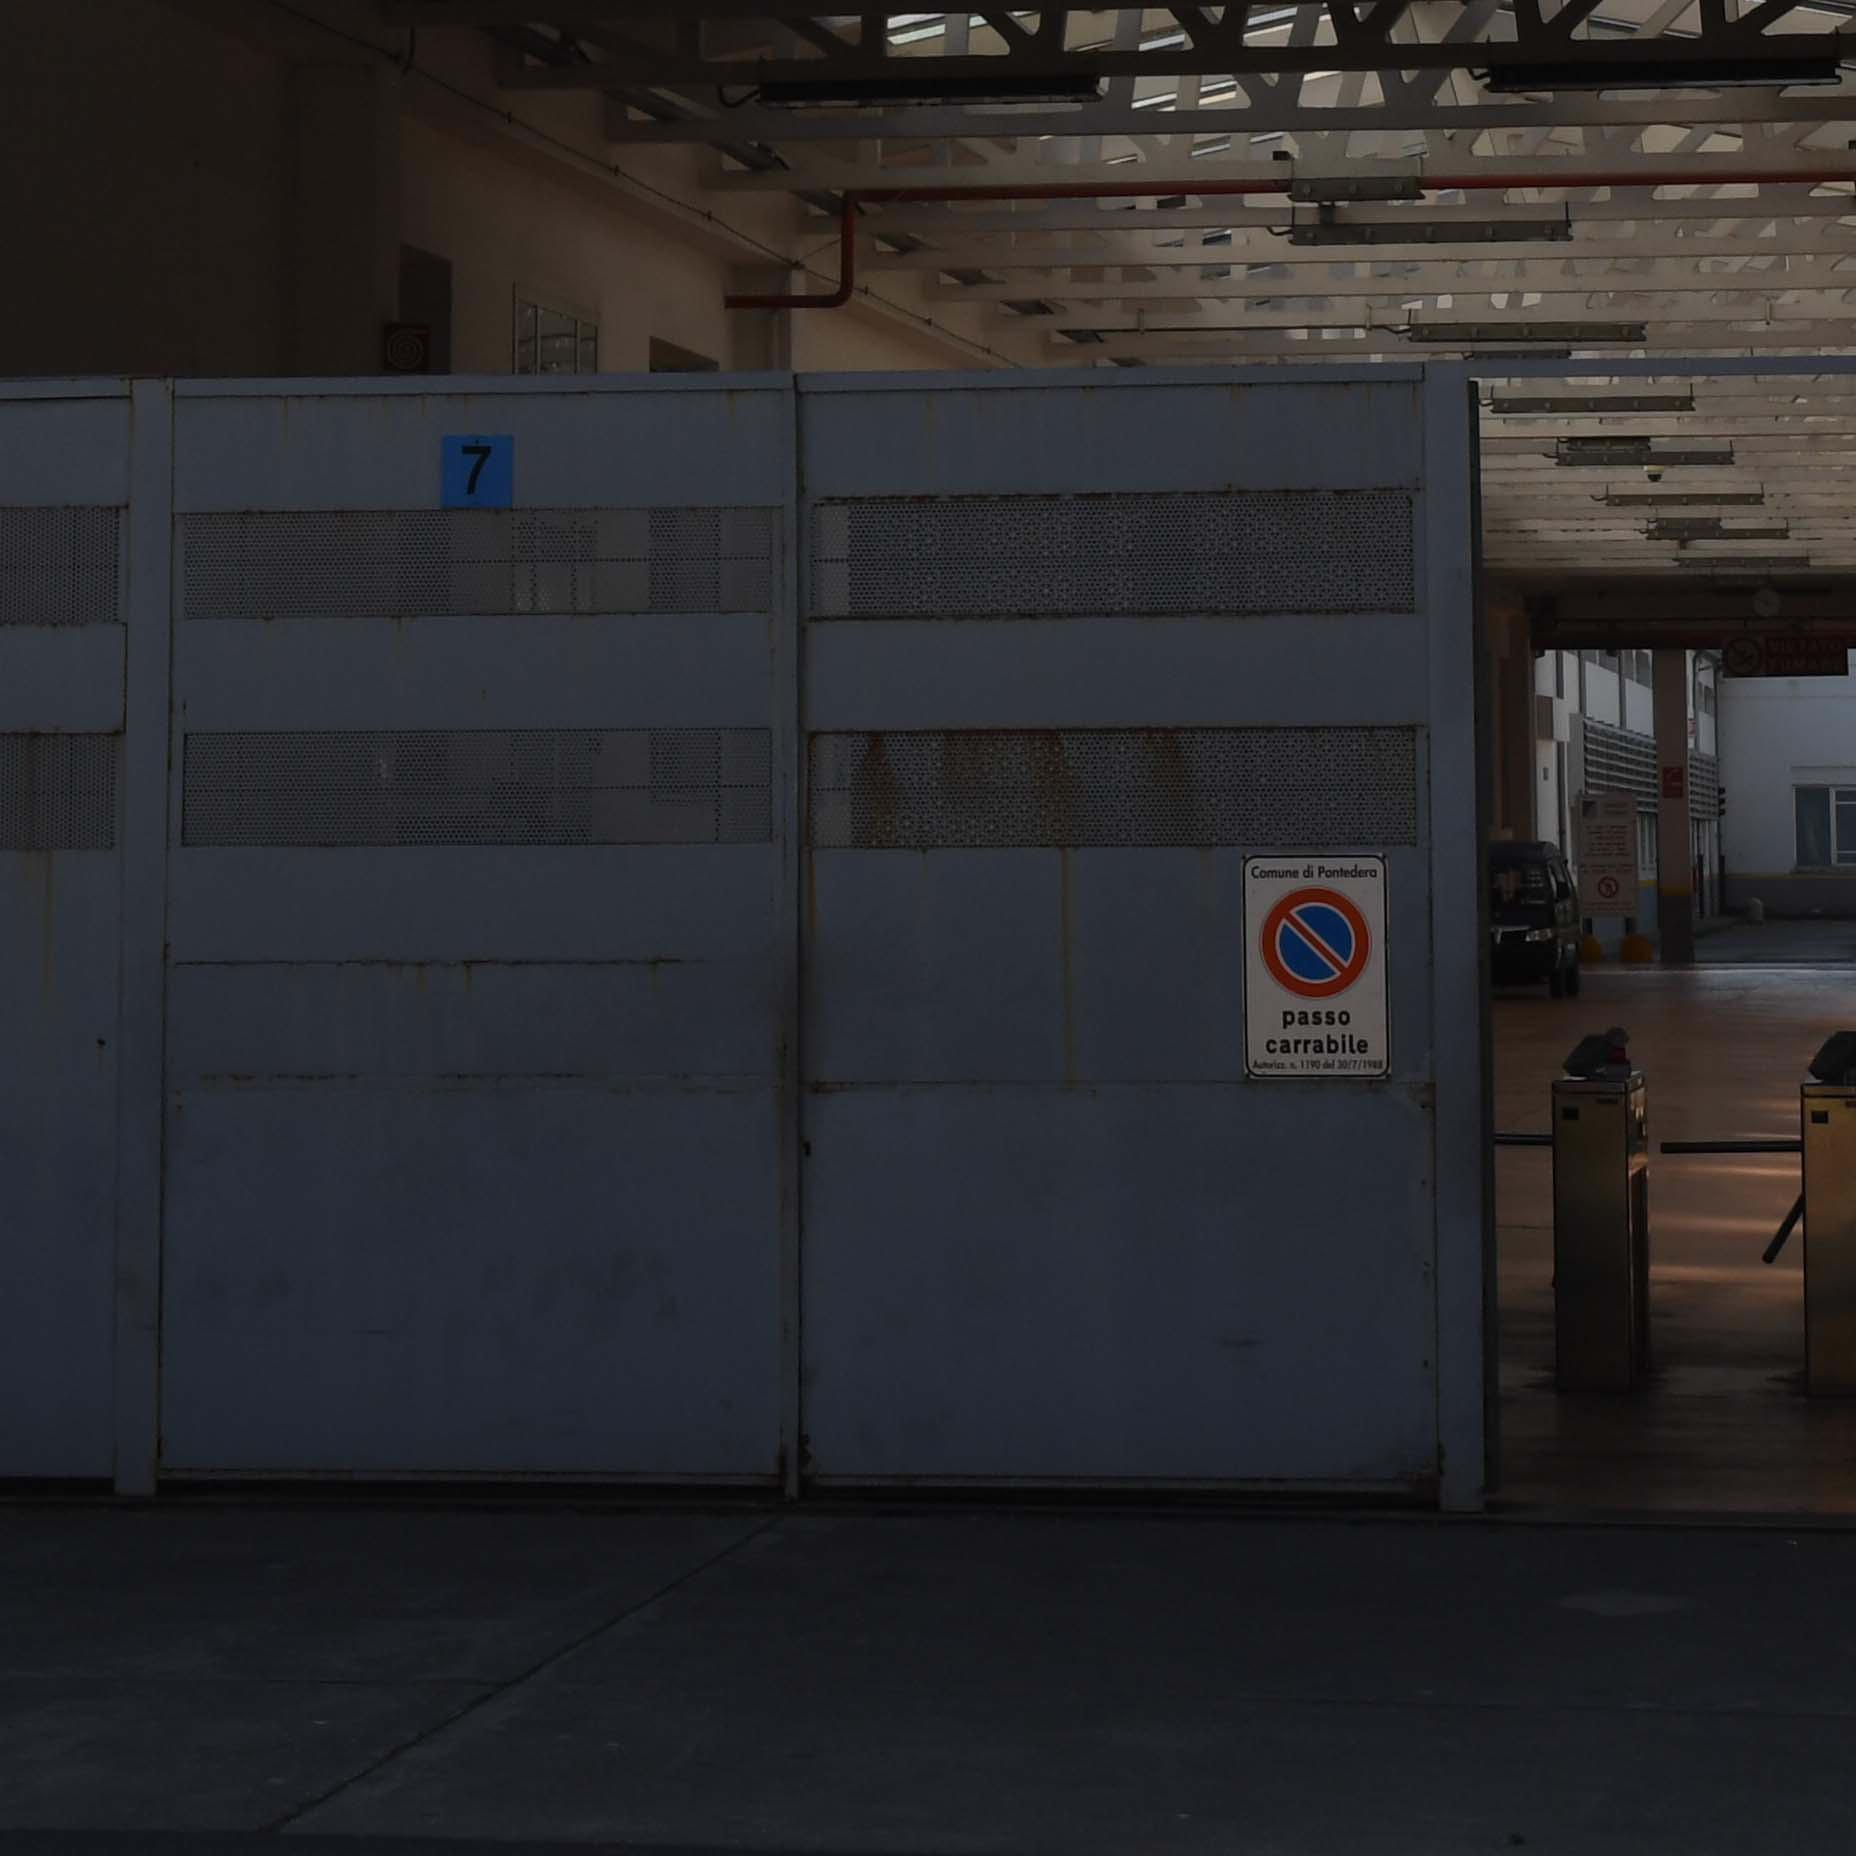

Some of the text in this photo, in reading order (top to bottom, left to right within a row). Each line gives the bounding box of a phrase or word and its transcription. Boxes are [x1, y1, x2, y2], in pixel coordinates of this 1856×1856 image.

[462, 446, 492, 495] 7
[1251, 864, 1377, 879] Comune di Pontedera
[1282, 1010, 1351, 1029] passo
[1265, 1034, 1369, 1054] carrabile
